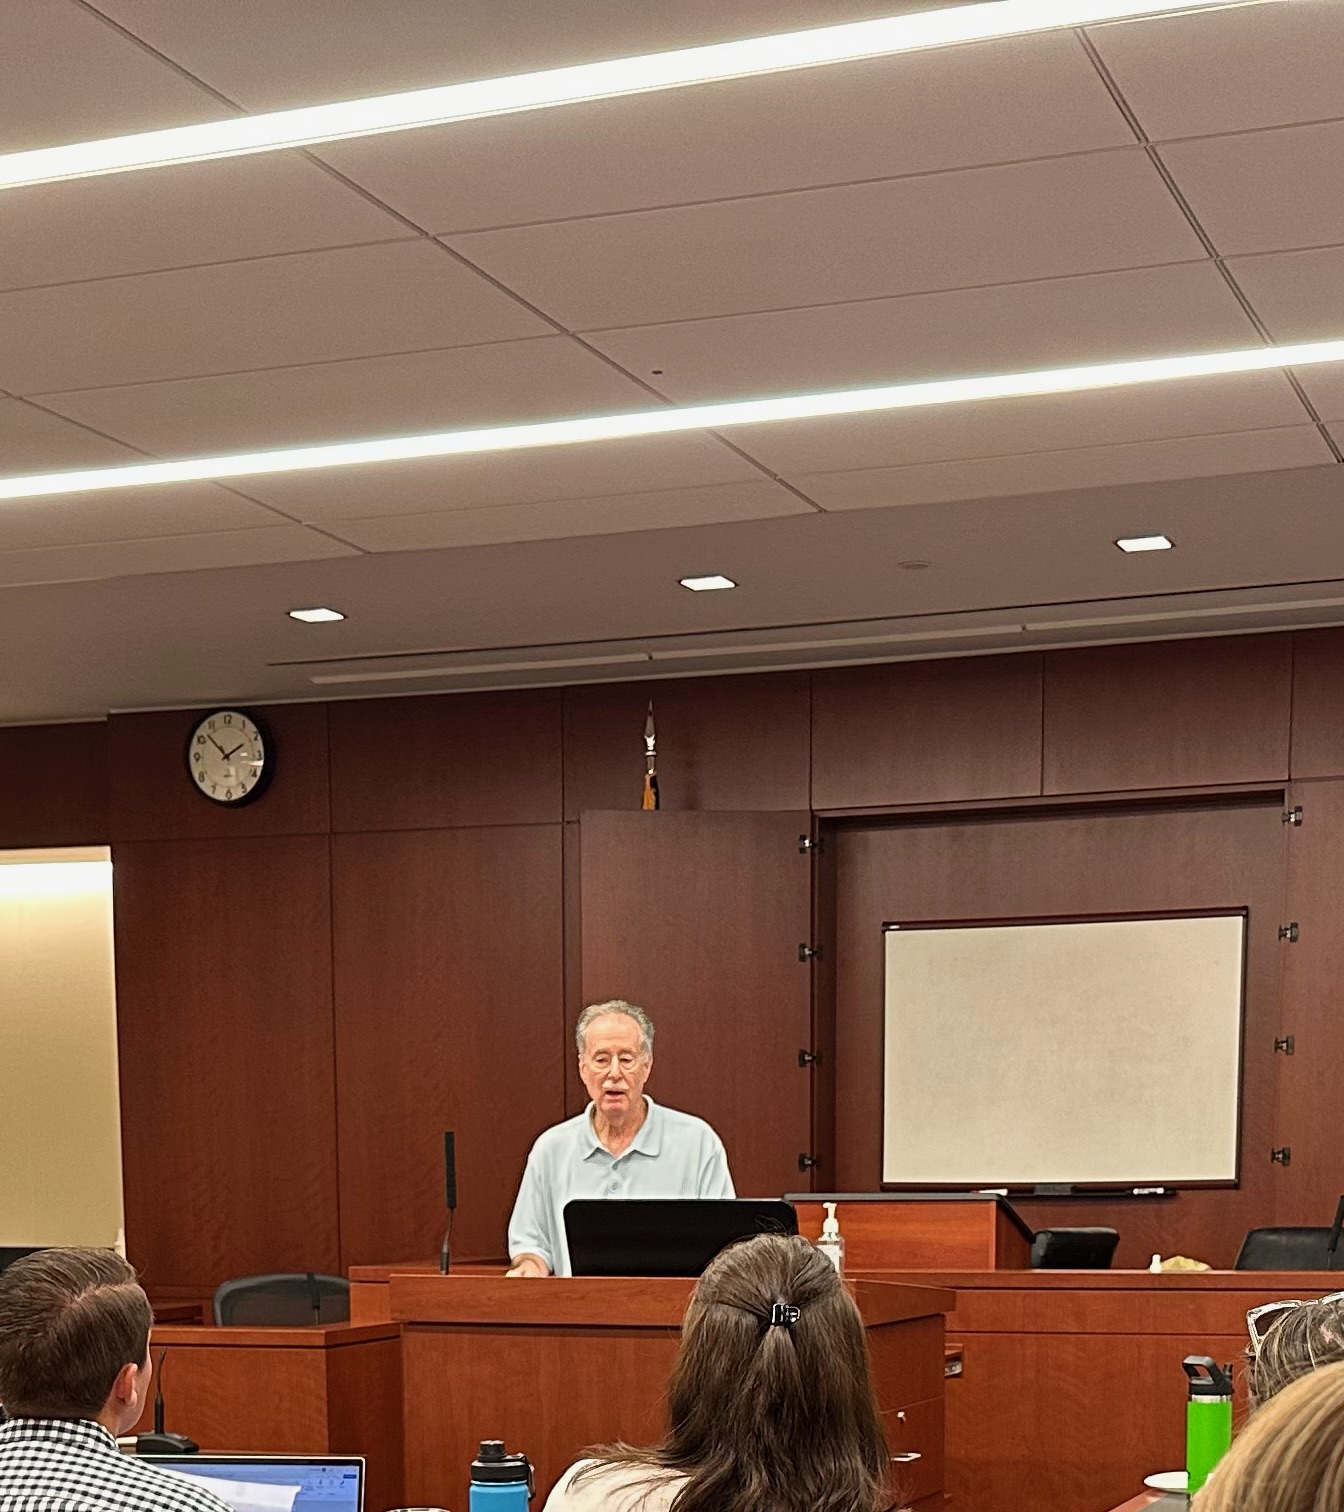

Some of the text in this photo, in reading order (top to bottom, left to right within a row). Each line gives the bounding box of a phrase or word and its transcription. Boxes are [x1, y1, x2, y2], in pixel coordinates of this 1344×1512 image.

[223, 714, 233, 725] 12
[194, 752, 201, 763] 9
[225, 789, 233, 800] 6
